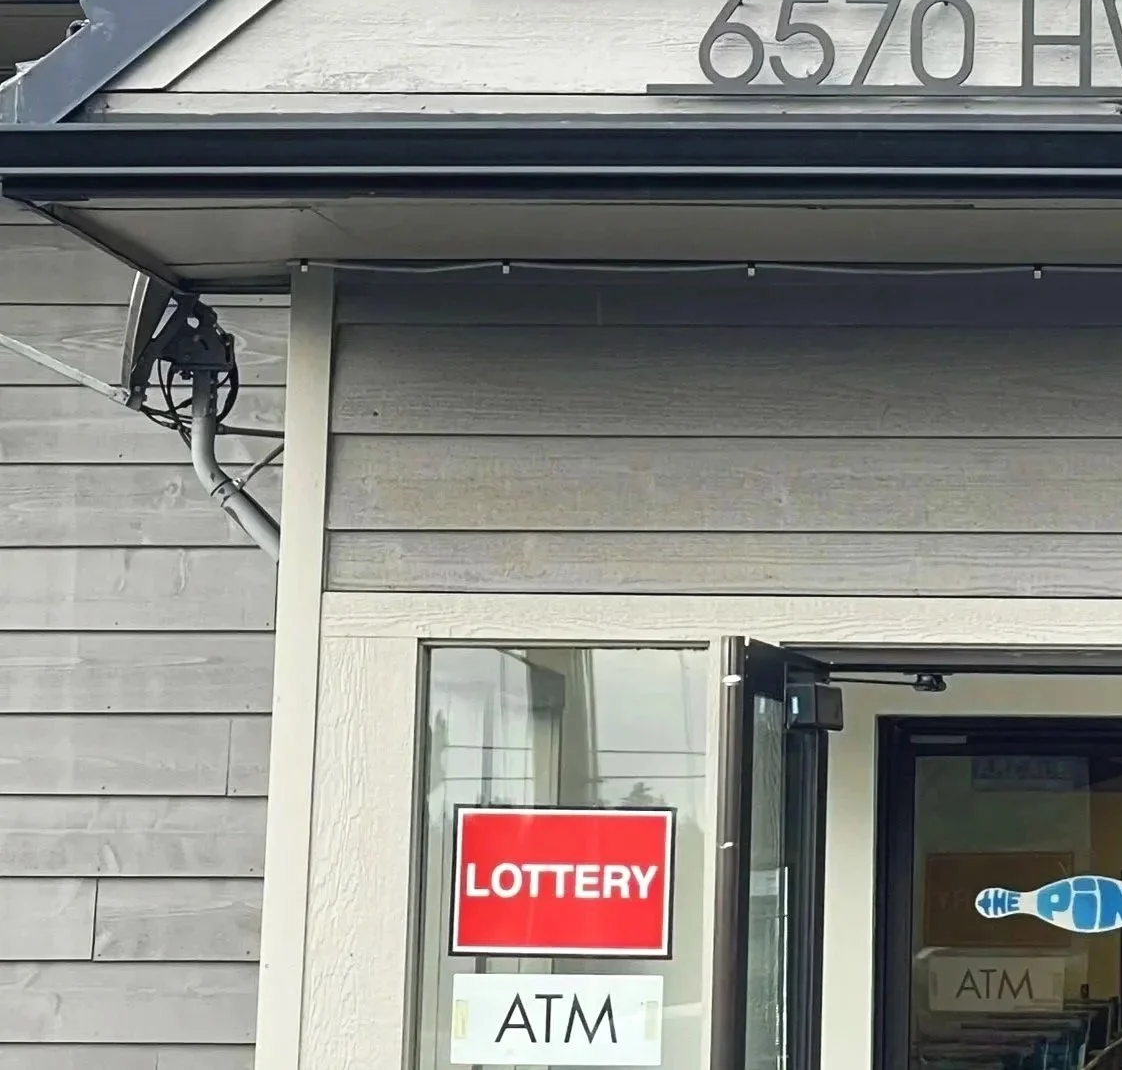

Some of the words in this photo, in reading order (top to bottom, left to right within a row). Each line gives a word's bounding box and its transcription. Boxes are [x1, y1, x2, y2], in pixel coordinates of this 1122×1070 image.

[465, 862, 659, 900] LOTTERY
[955, 967, 1034, 1000] ATM
[494, 992, 618, 1044] ATM
